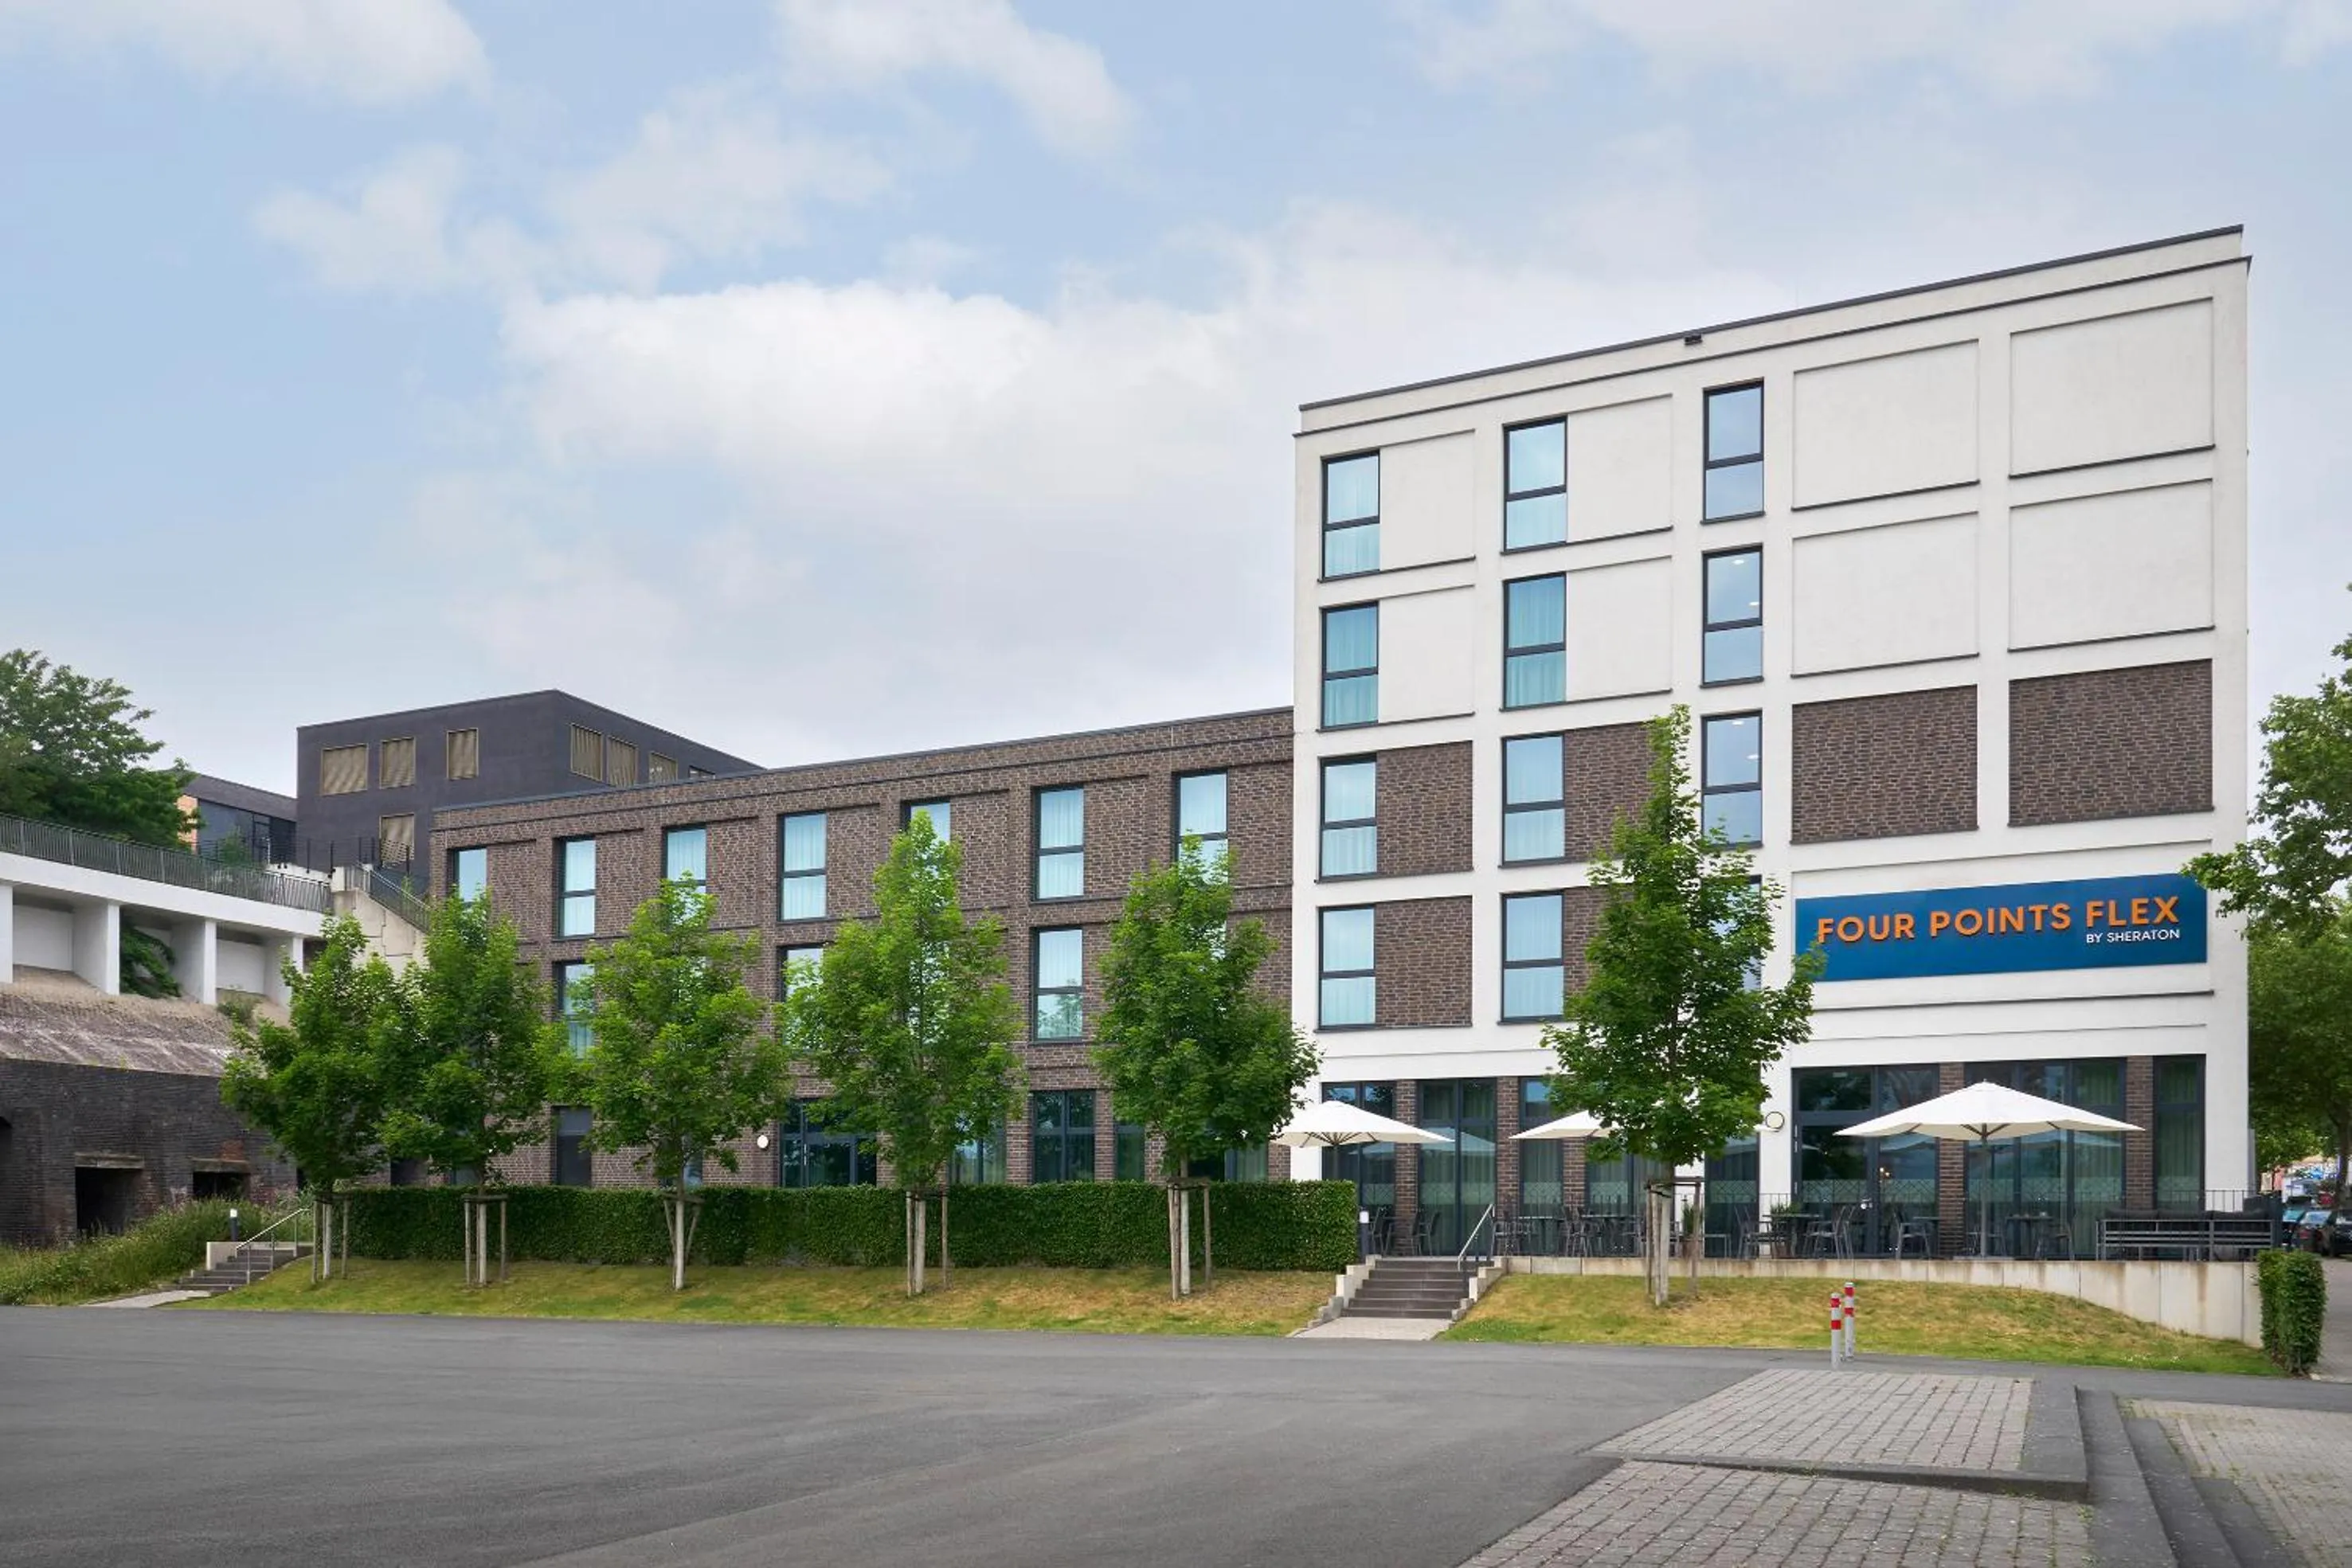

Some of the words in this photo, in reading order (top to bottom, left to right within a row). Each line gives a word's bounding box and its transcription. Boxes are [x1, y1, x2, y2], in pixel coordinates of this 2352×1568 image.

[1817, 913, 1916, 944] FOUR
[1929, 902, 2072, 937] POINTS
[2085, 896, 2180, 928] FLEX
[2086, 933, 2103, 944] BY
[2107, 929, 2181, 944] SHERATON
